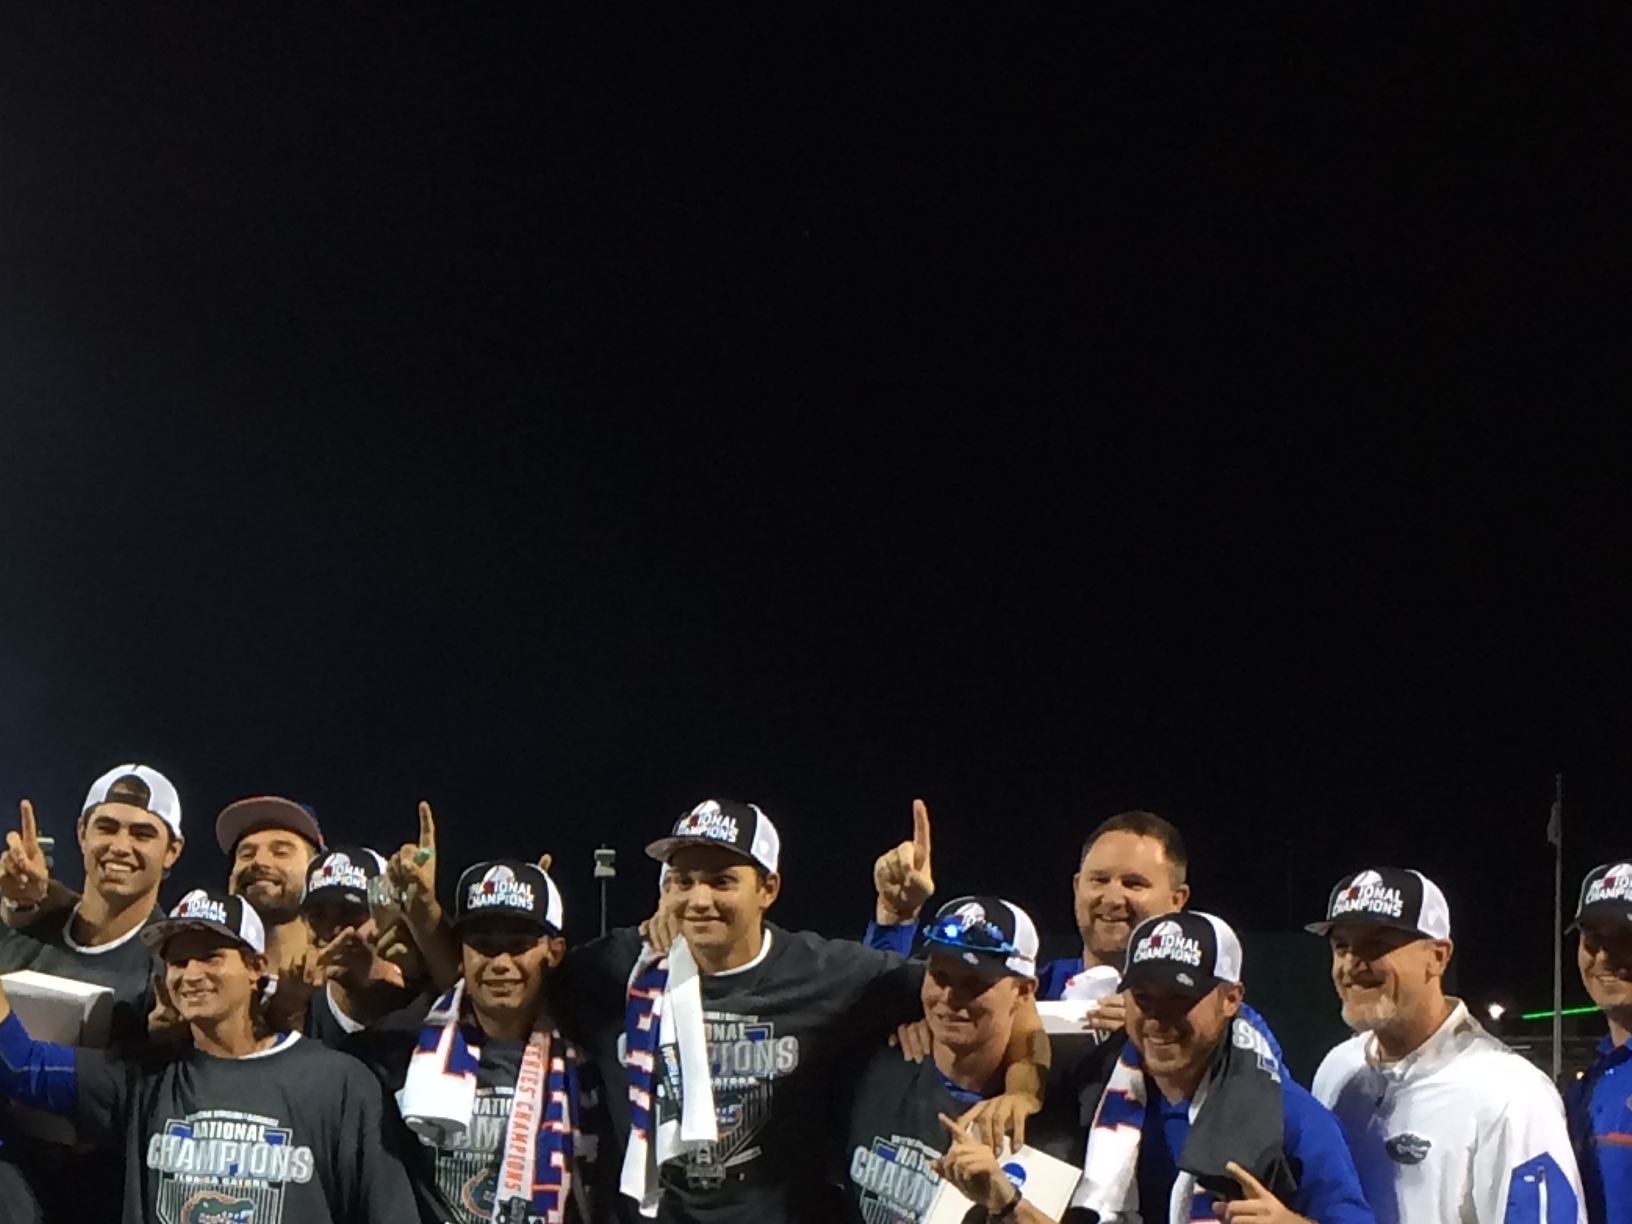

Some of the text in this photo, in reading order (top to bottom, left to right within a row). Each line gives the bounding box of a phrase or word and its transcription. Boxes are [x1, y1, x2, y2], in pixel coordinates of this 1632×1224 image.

[193, 1121, 266, 1143] NATIONAL
[505, 1101, 534, 1193] CHAMPIONS
[147, 1133, 314, 1184] CHAMPIONS
